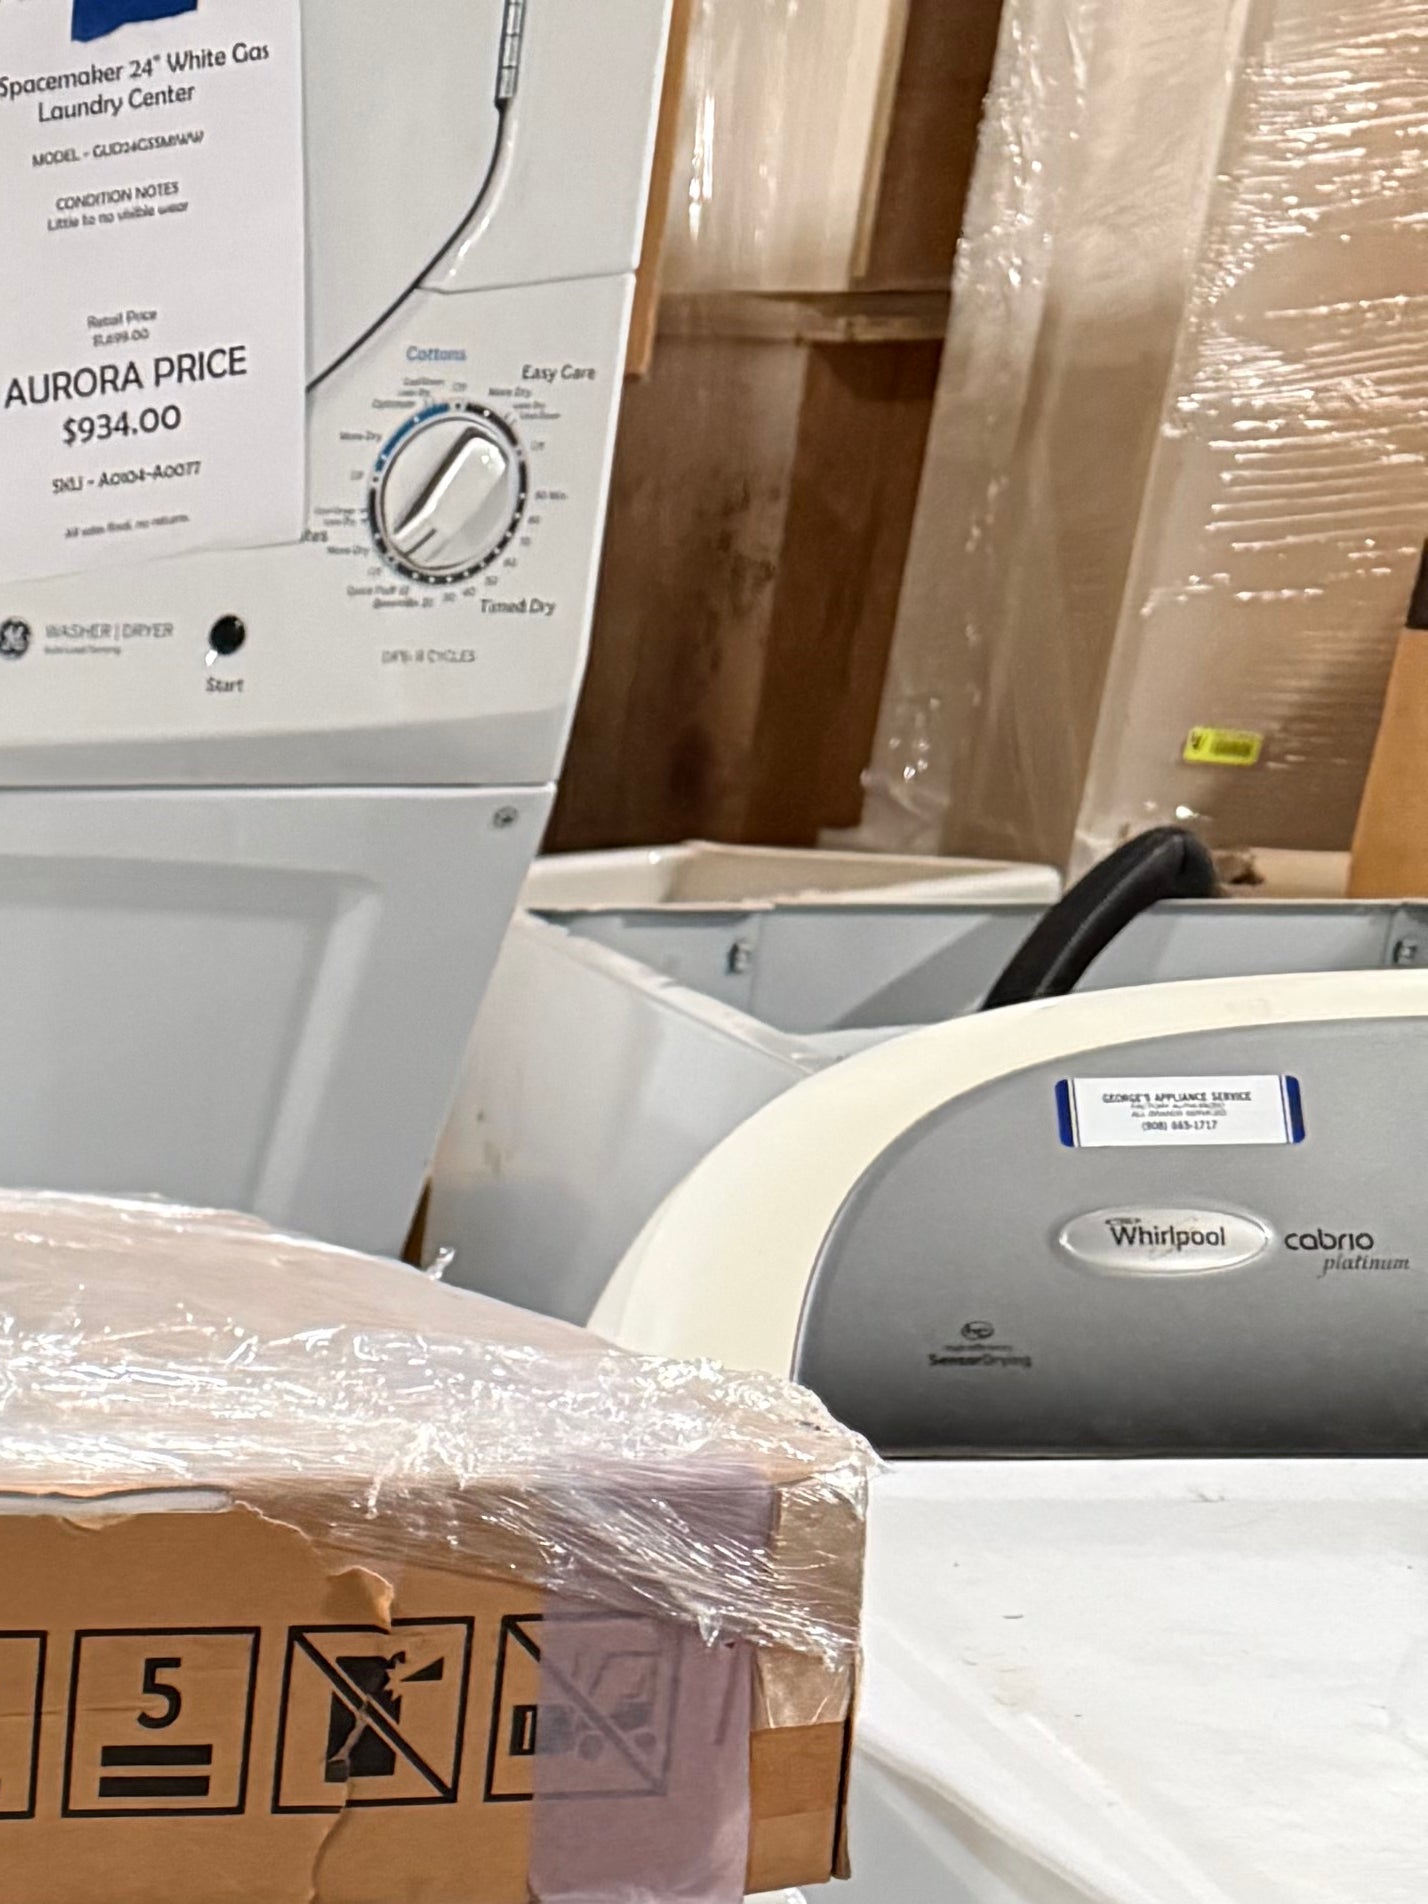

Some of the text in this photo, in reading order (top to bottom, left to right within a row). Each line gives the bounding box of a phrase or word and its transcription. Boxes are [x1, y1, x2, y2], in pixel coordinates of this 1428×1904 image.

[129, 54, 161, 78] 24"
[167, 48, 226, 73] White
[232, 43, 269, 63] Gas
[38, 84, 195, 122] Laundry Center
[32, 149, 80, 167] MODEL
[56, 181, 179, 211] CONDITION NOTES
[47, 217, 79, 231] Little
[82, 214, 96, 225] to
[99, 212, 115, 224] no
[126, 309, 157, 324] Price
[3, 345, 247, 409] AURORA PRICE
[521, 364, 596, 383] Easy Care
[62, 404, 181, 448] $934.00
[480, 597, 557, 616] Timed Dry
[205, 676, 245, 693] Start
[1109, 1225, 1226, 1252] Whirlpool
[1284, 1228, 1374, 1252] cabrio
[1318, 1253, 1411, 1278] platinum
[135, 1656, 182, 1729] 5
